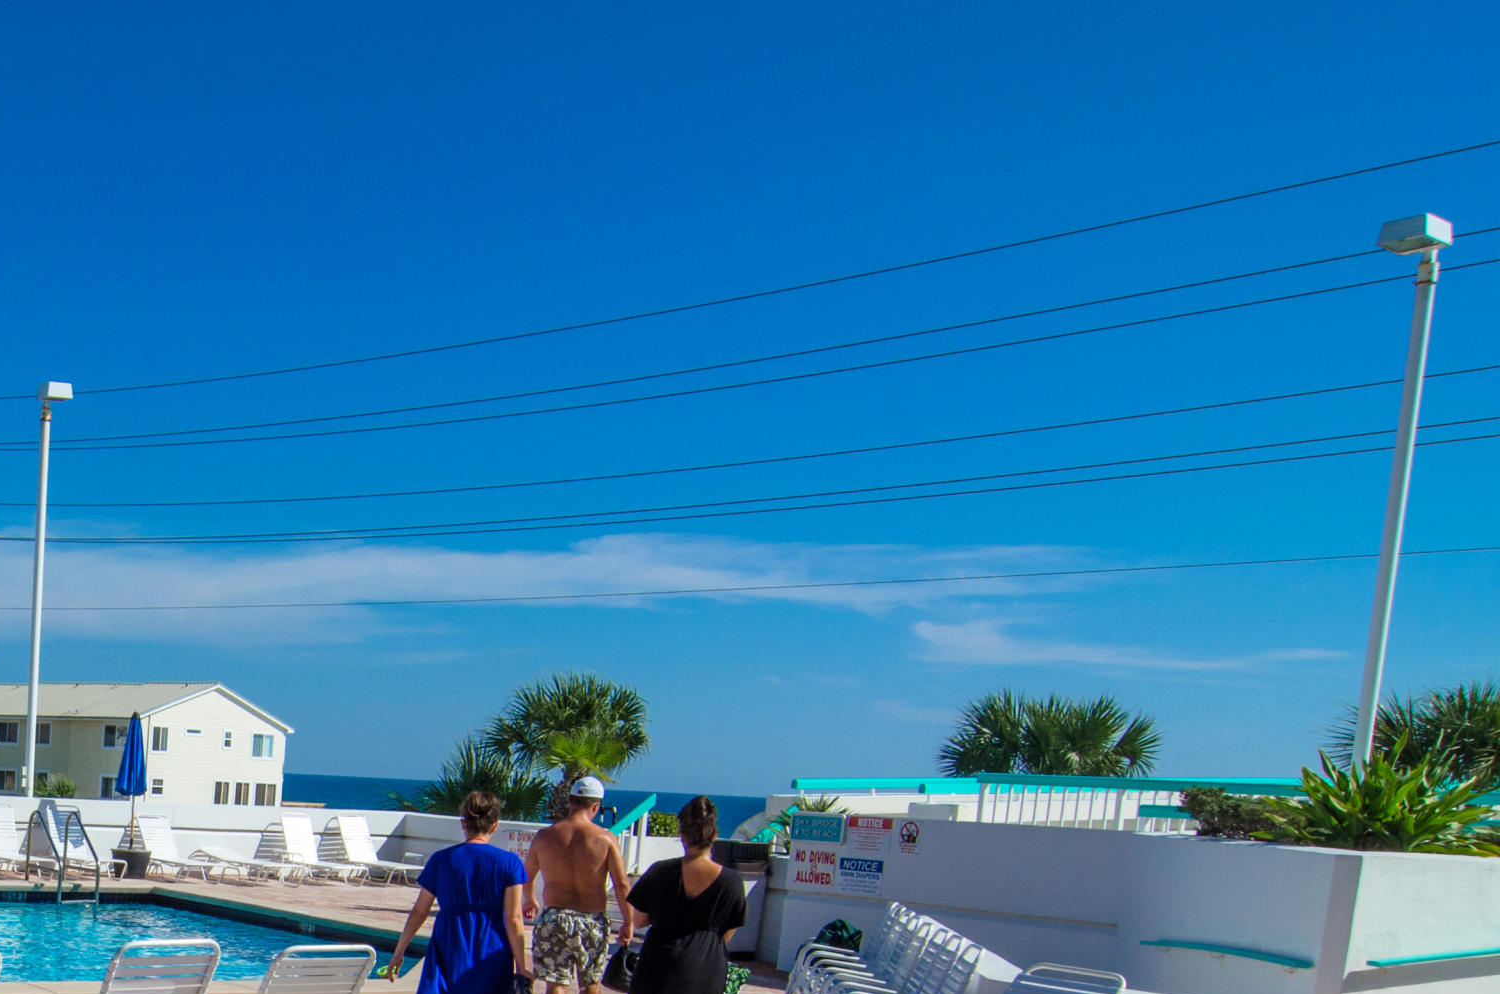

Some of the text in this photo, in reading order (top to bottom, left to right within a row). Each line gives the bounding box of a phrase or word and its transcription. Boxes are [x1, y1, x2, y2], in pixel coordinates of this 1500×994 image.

[812, 819, 838, 828] BRIDGE
[858, 819, 883, 828] NOTICE
[813, 830, 837, 838] BEACH
[795, 850, 835, 865] NO DIVING
[842, 860, 879, 871] NOTICE
[795, 870, 832, 885] ALLOWED
[855, 872, 880, 880] DIAPERS
